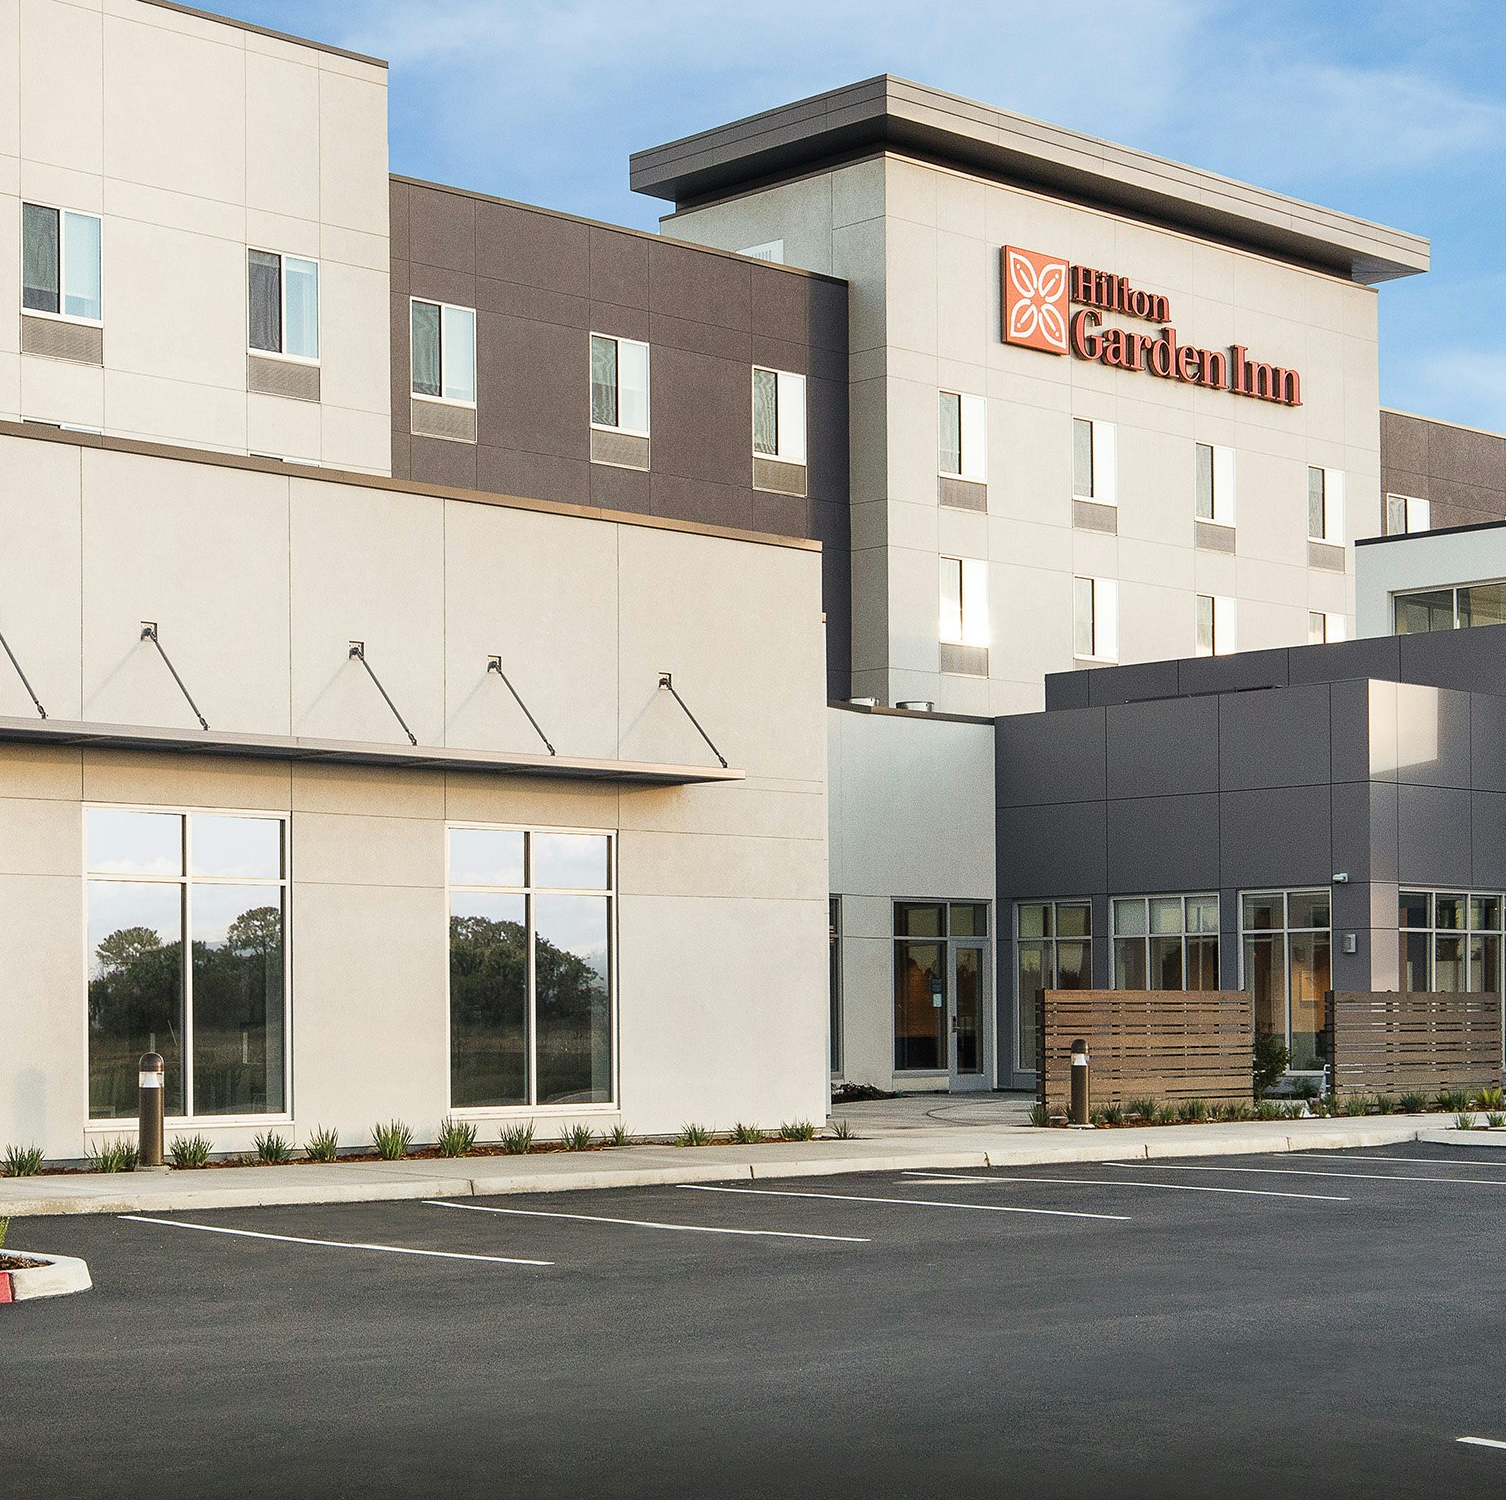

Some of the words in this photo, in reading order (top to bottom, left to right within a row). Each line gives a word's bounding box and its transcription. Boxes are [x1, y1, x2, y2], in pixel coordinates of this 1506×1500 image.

[1071, 264, 1172, 324] Hilton
[1071, 308, 1228, 390] Garden
[1230, 344, 1303, 406] Inn
